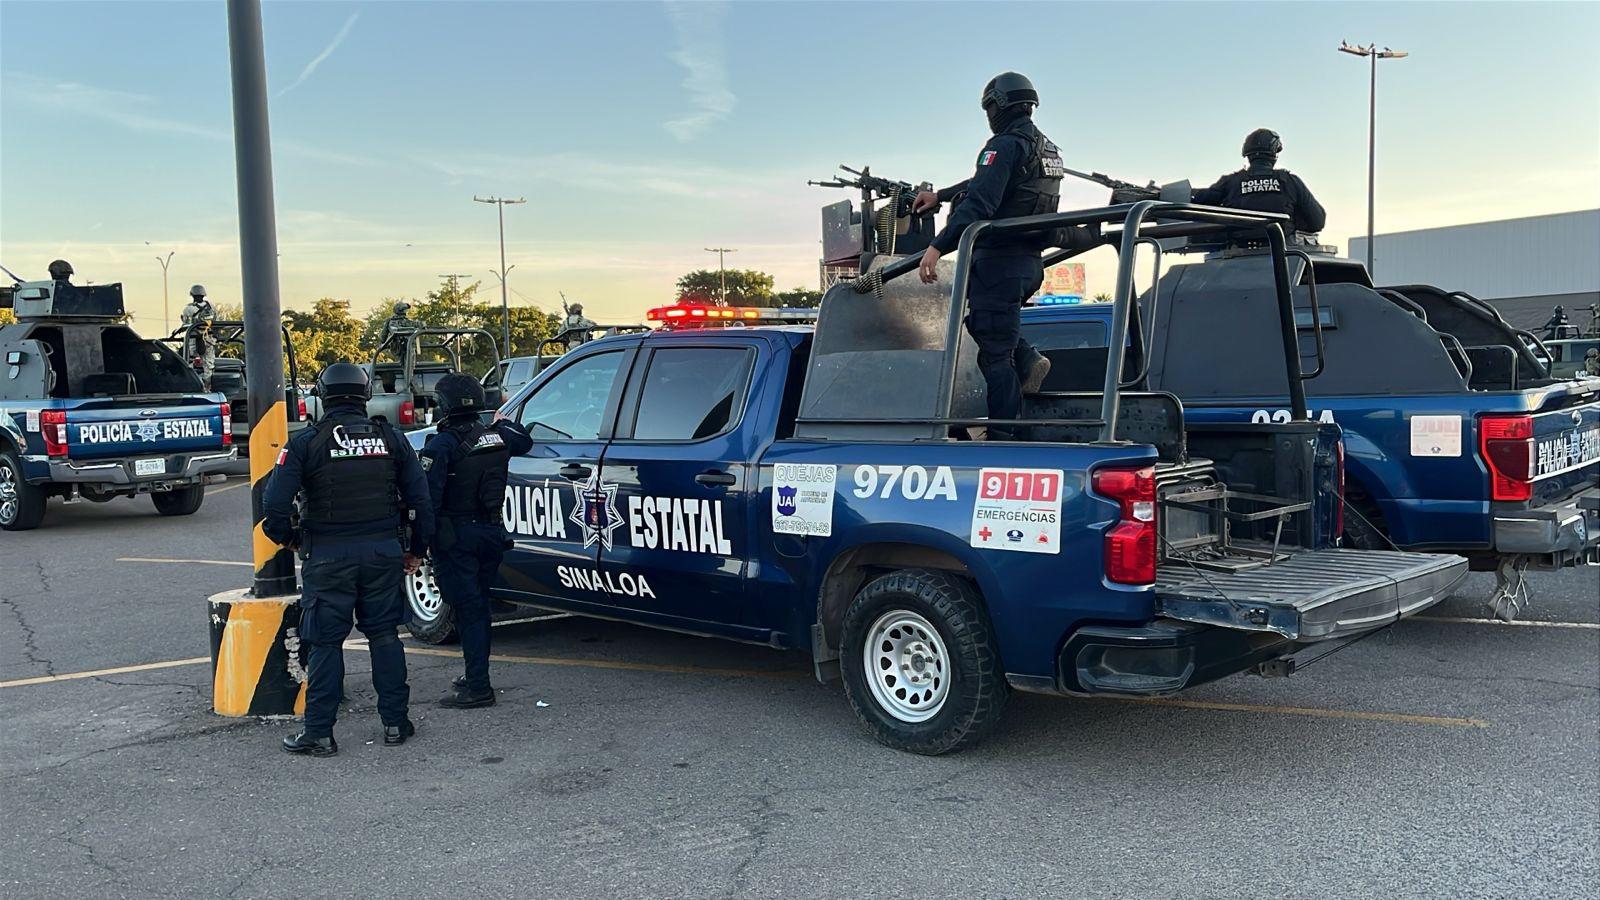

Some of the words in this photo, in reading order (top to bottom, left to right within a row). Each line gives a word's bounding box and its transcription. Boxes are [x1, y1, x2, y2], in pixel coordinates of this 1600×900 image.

[1241, 185, 1280, 194] ESTATAL
[80, 420, 133, 444] POLICÍA
[163, 419, 213, 439] ESTATAL
[330, 447, 388, 458] ESTATAL
[776, 465, 834, 483] QUEJAS
[853, 464, 957, 501] 970A
[986, 476, 1050, 498] 911
[778, 496, 795, 507] UAI
[502, 478, 567, 539] OLICÍA
[628, 495, 732, 555] ESTATAL
[977, 510, 1056, 523] EMERGENCIAS
[557, 564, 657, 599] SINALOA
